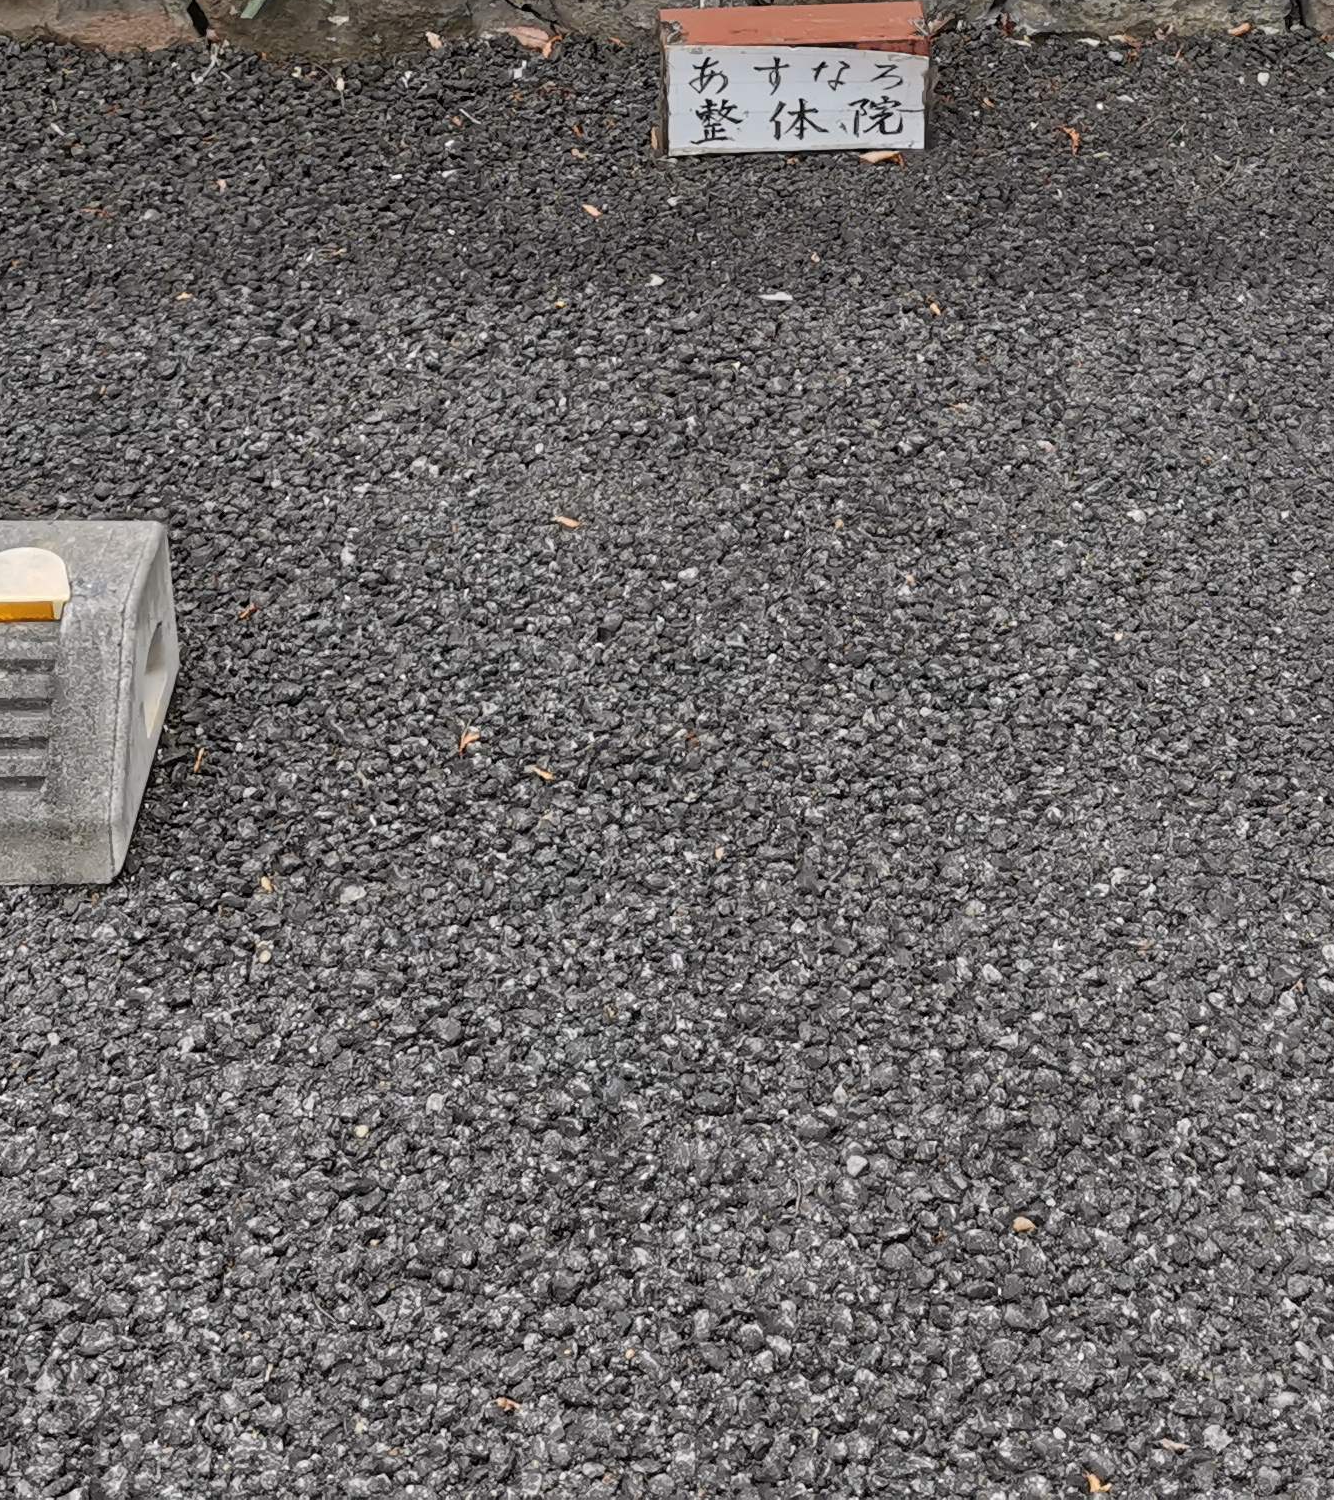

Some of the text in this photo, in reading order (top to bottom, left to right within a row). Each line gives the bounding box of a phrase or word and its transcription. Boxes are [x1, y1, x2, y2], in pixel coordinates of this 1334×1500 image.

[688, 56, 905, 96] あすなろ
[690, 96, 904, 145] 整体院
